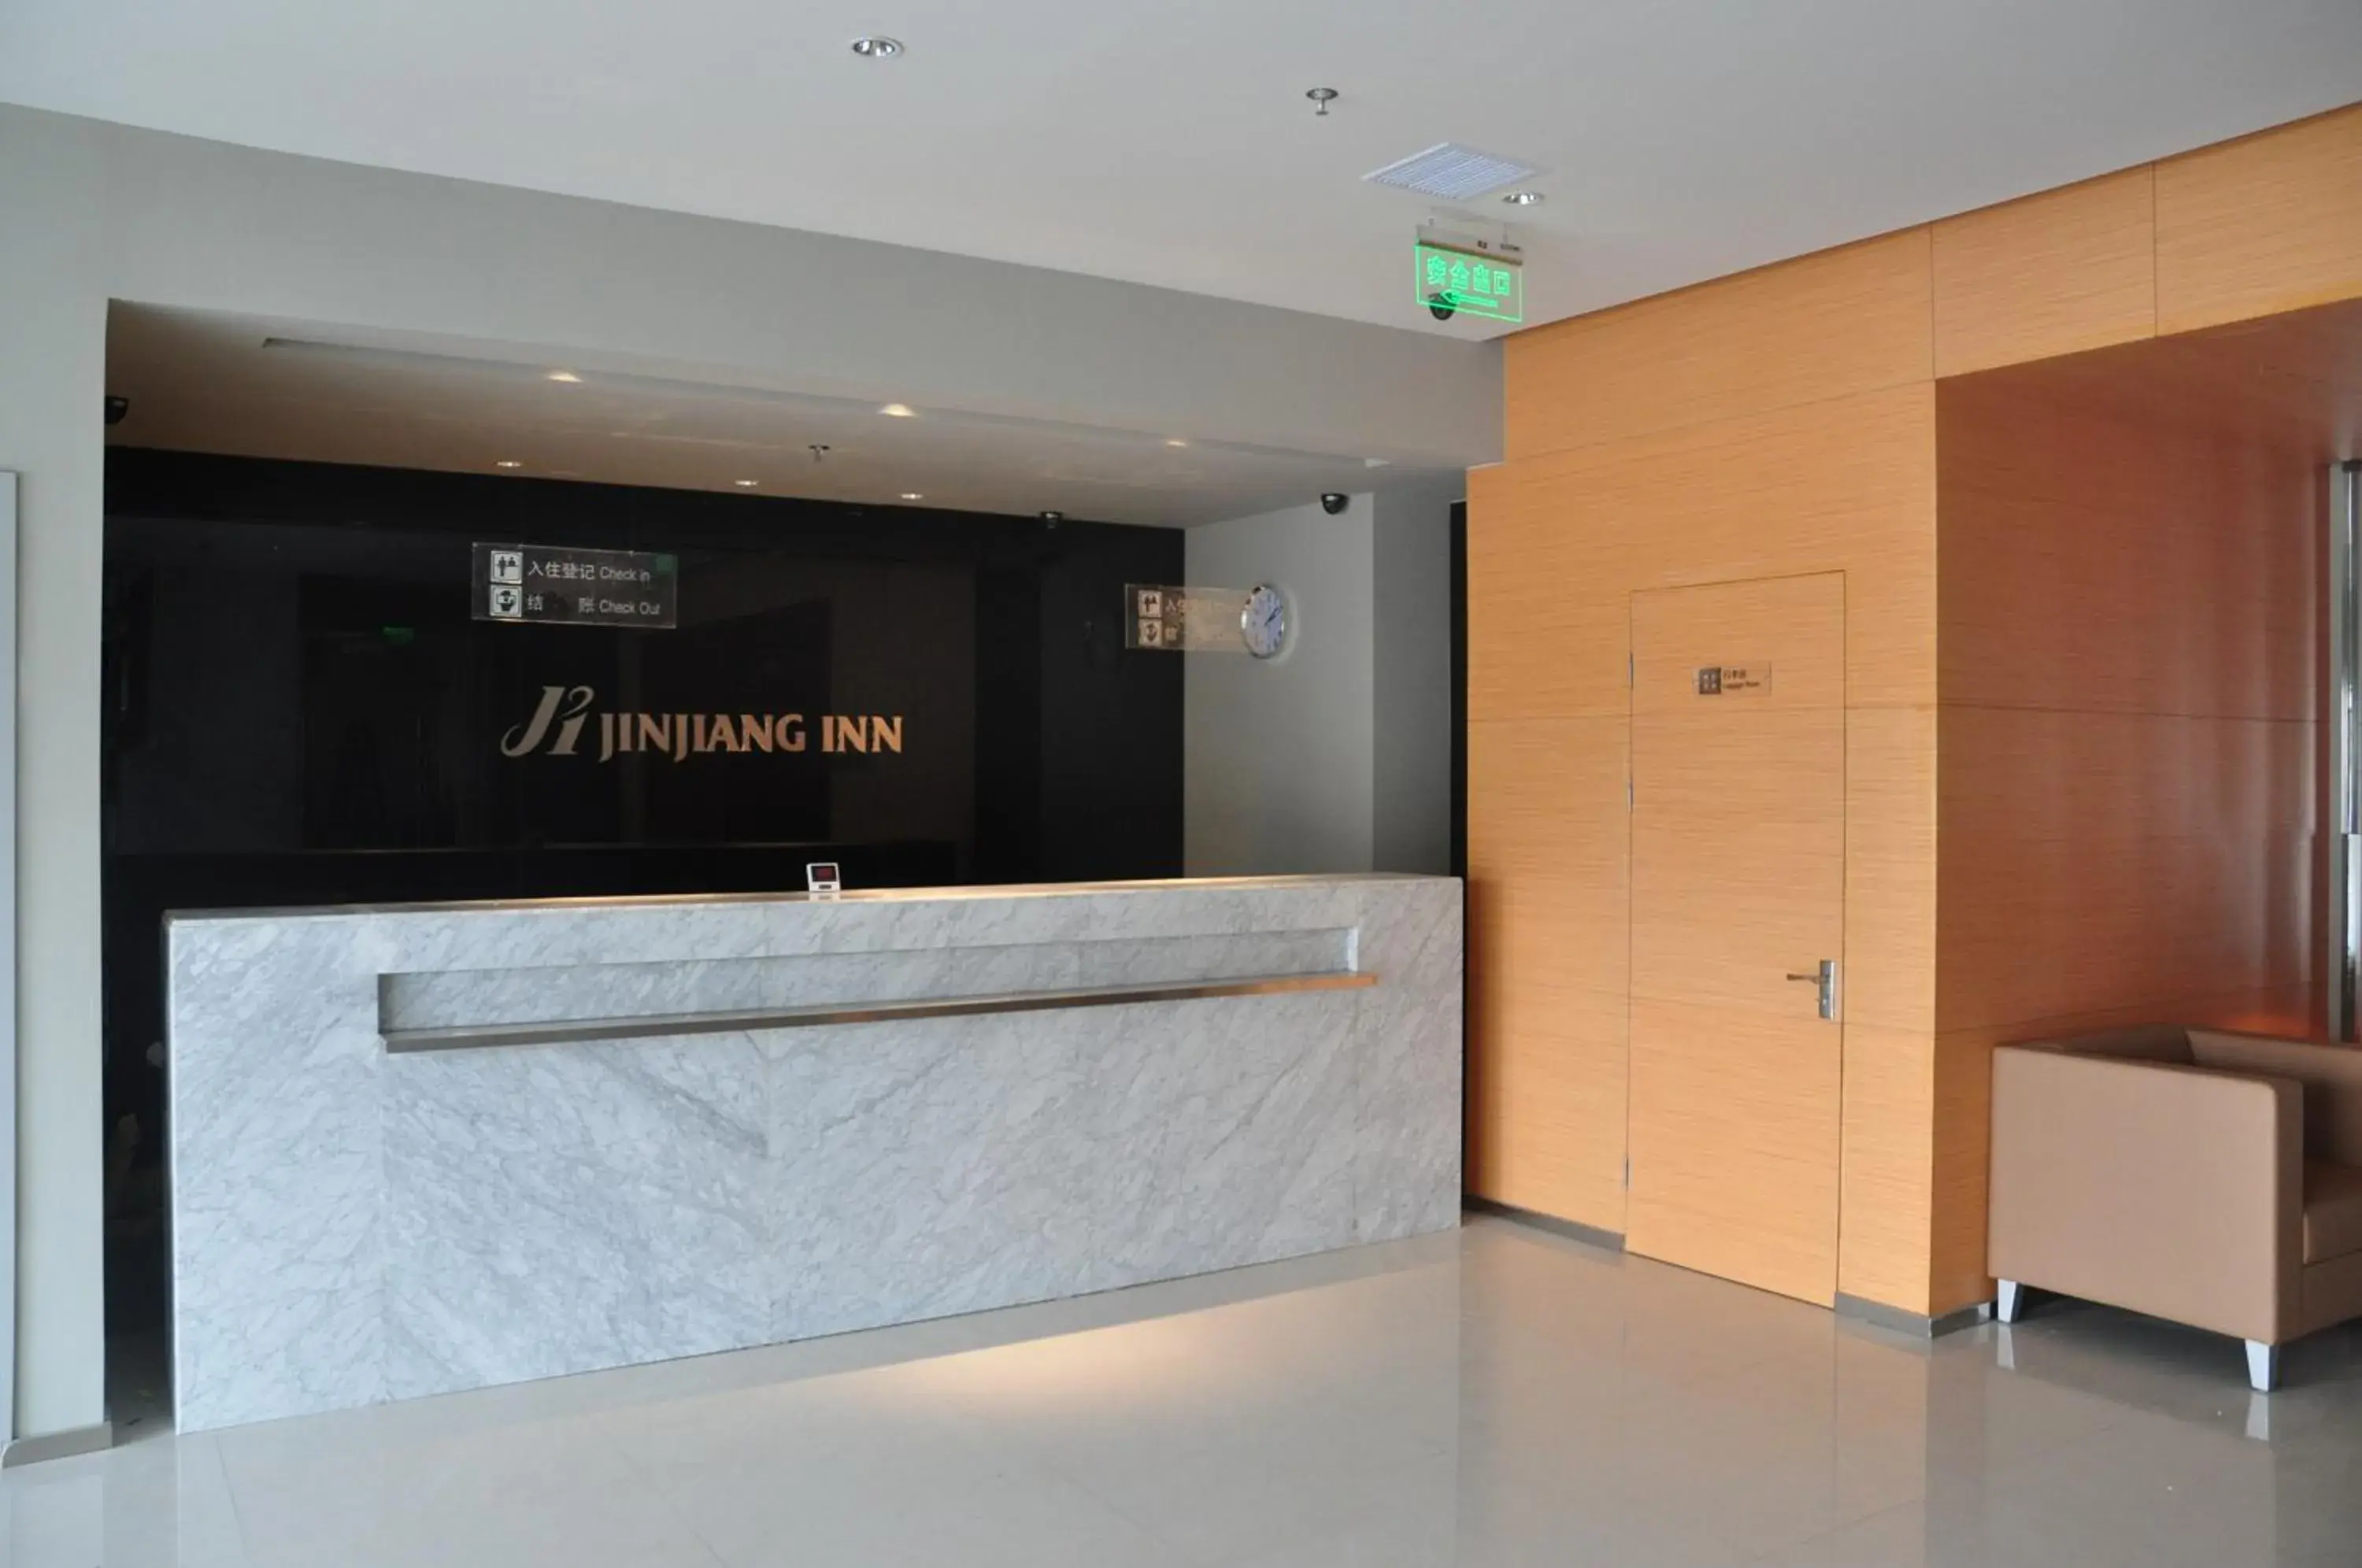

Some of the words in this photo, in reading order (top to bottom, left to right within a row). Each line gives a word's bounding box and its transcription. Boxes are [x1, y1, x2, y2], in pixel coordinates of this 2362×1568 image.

[1427, 255, 1511, 297] 安全出口
[528, 560, 594, 581] 入住登记
[599, 566, 638, 581] Check
[599, 599, 635, 614] Check
[639, 601, 661, 616] Out
[599, 712, 807, 764] JINJIANG
[820, 714, 904, 754] INN
